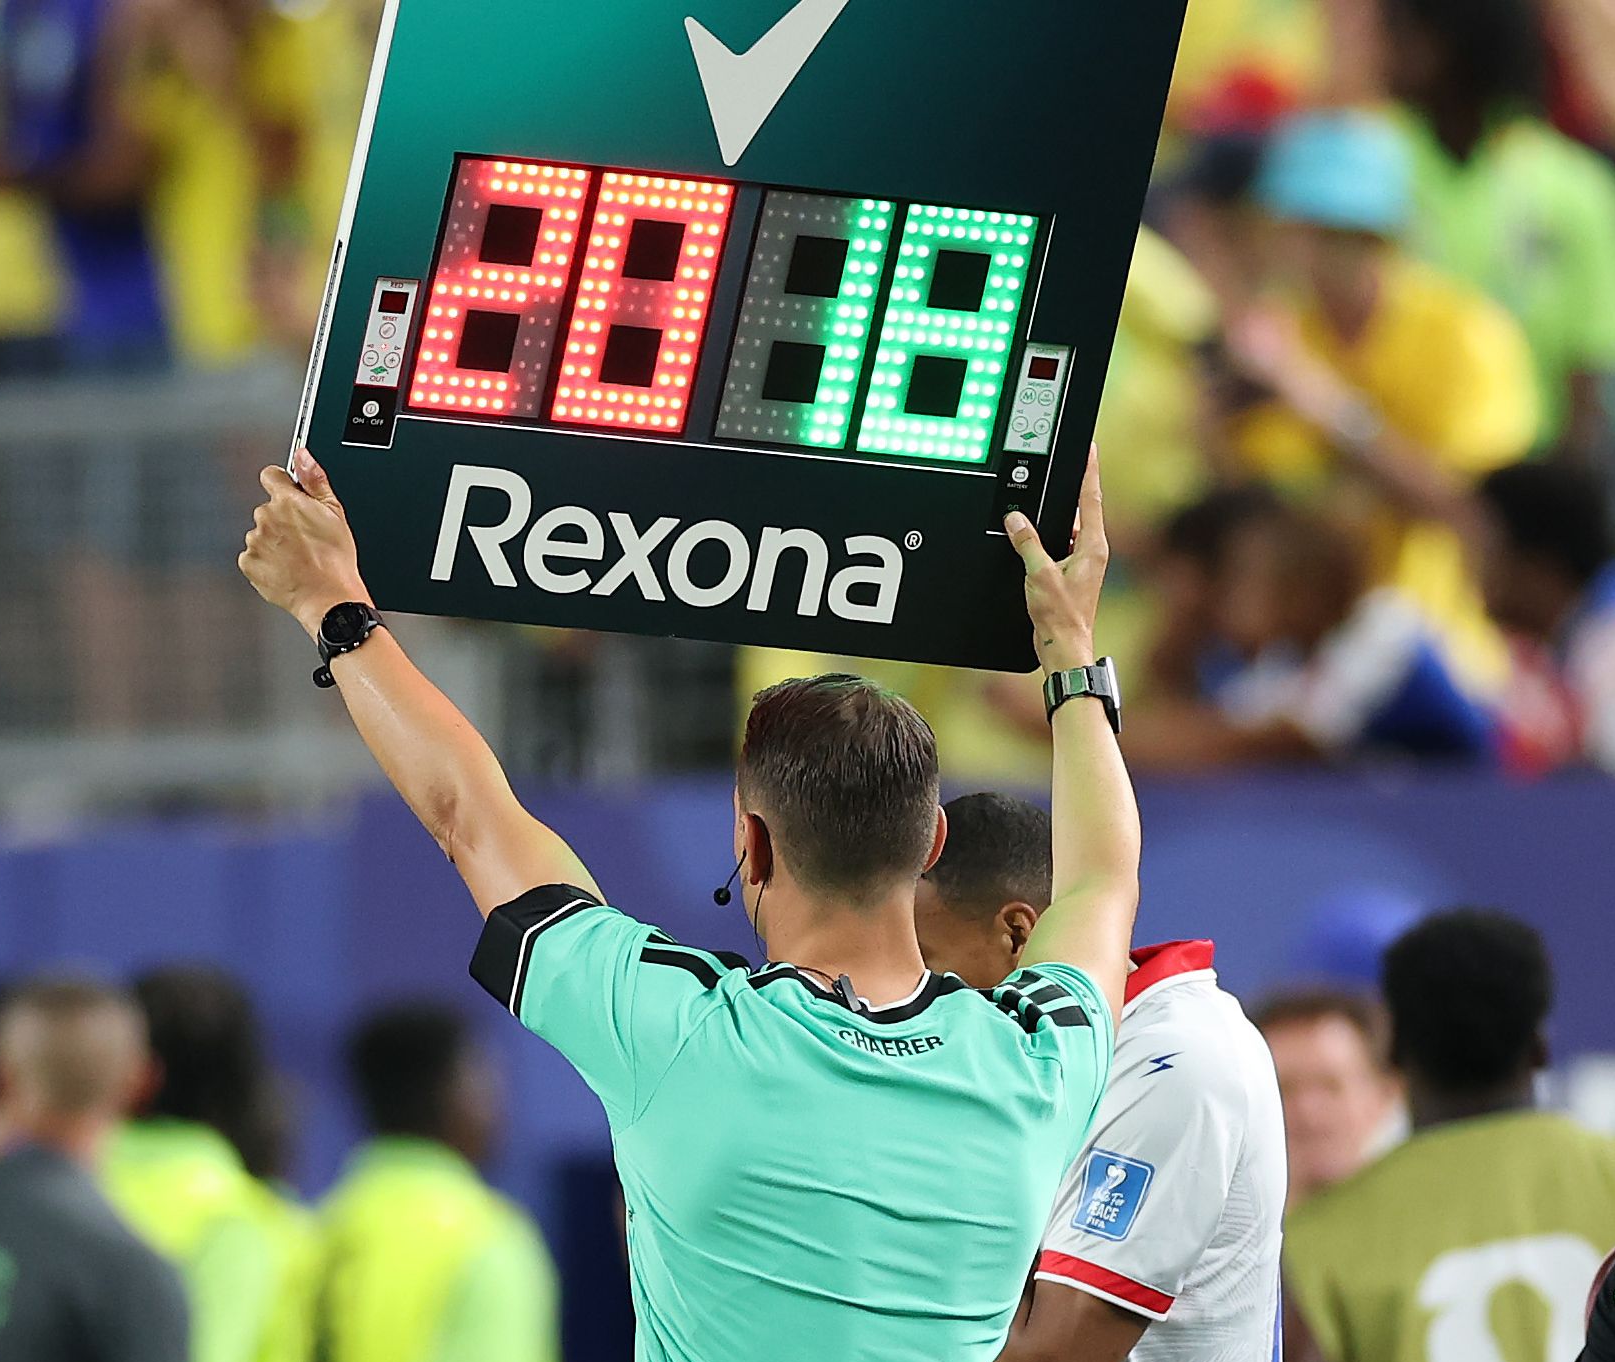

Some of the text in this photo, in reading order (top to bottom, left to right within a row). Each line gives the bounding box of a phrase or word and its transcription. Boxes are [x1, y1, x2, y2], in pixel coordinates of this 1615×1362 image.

[408, 158, 1038, 463] 20 18
[369, 375, 385, 383] OUT
[829, 1028, 945, 1057] CHAERER
